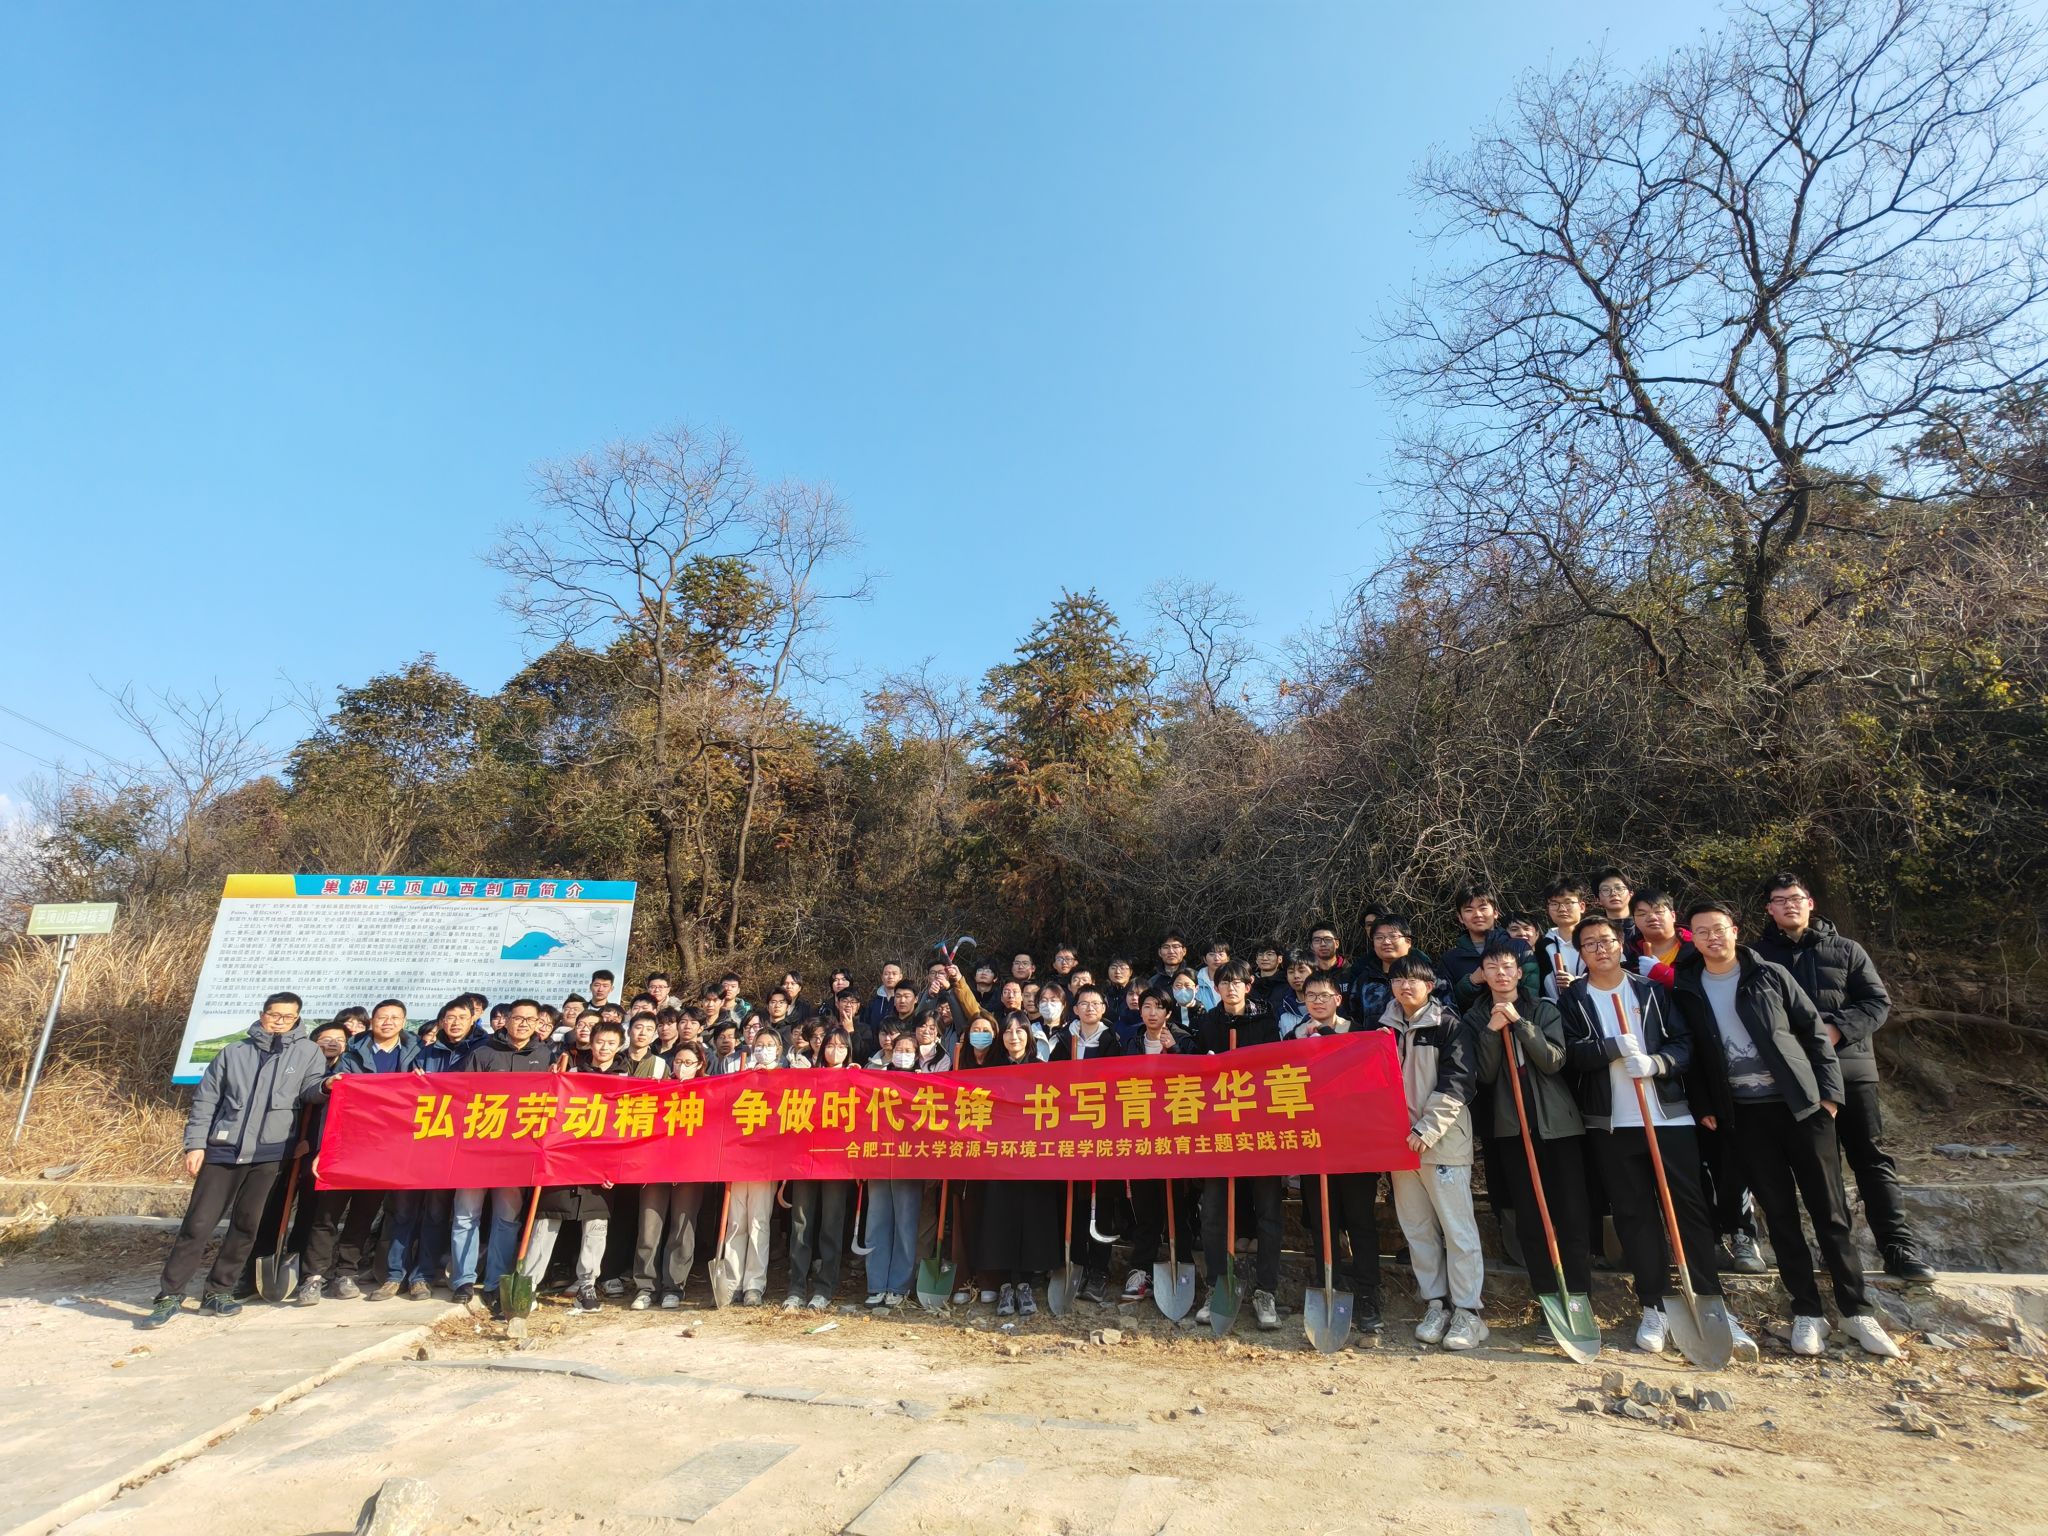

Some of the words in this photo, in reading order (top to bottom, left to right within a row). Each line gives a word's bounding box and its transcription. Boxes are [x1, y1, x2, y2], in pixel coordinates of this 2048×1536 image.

[322, 879, 584, 897] 巢湖平顶山西剖面简介
[413, 1091, 706, 1140] 弘扬劳动精神
[732, 1084, 994, 1136] 争做时代先锋
[1022, 1065, 1314, 1132] 书写青春华章
